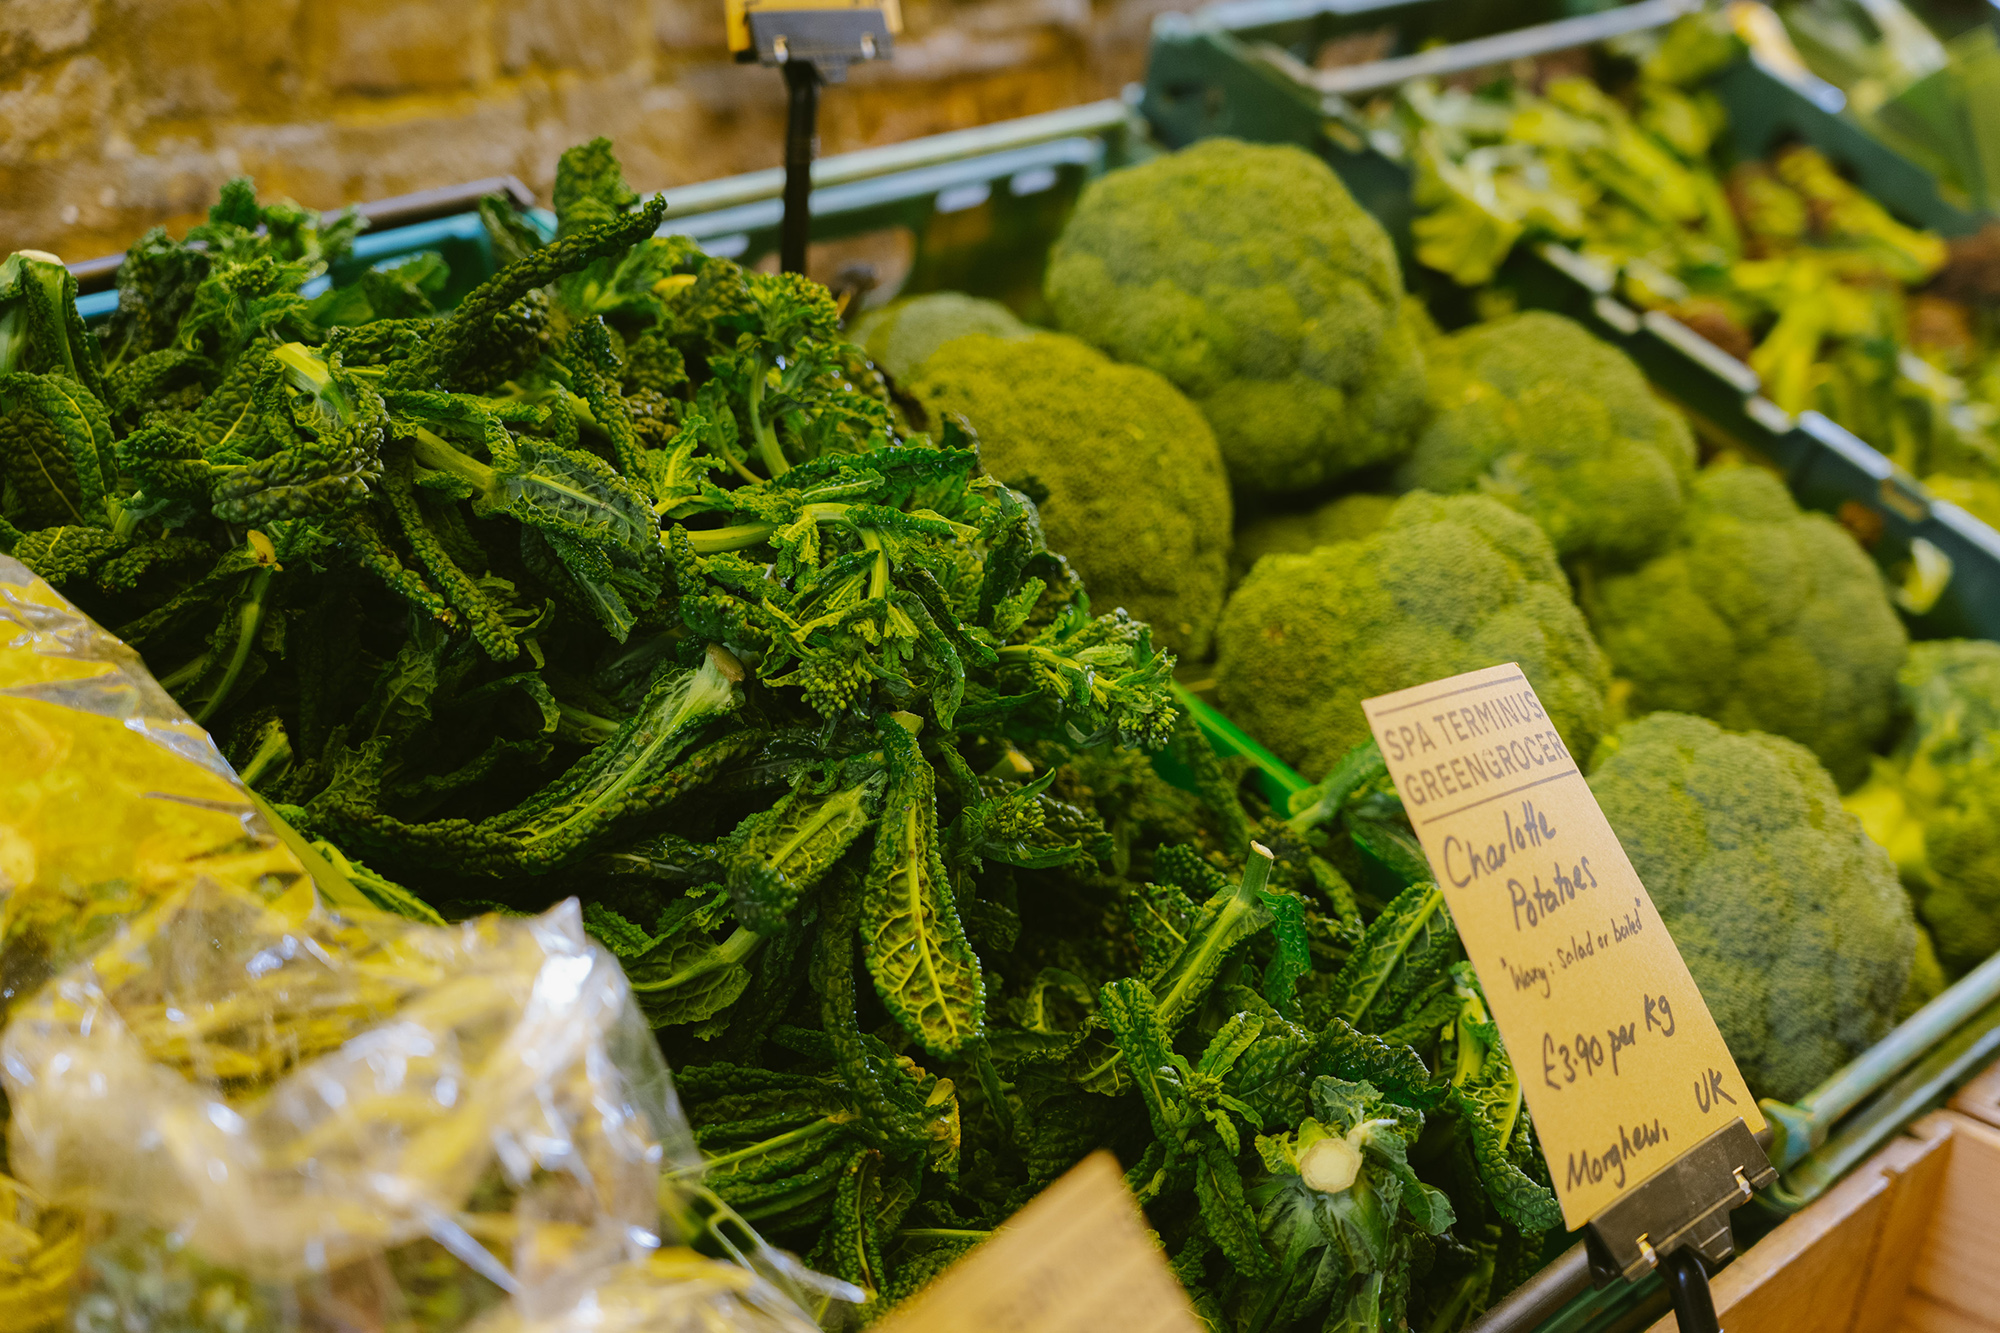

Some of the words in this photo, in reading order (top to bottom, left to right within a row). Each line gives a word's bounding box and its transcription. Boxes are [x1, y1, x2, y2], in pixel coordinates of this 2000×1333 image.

[1385, 719, 1436, 761] SPA
[1434, 690, 1544, 744] TERMINUS
[1405, 730, 1568, 805] GREENGROCER
[1443, 801, 1556, 889] Charlotte
[1508, 856, 1597, 931] Potatoes
[1597, 933, 1608, 949] or
[1543, 1032, 1604, 1091] £3.90
[1607, 1022, 1635, 1076] per
[1694, 1068, 1736, 1113] UK
